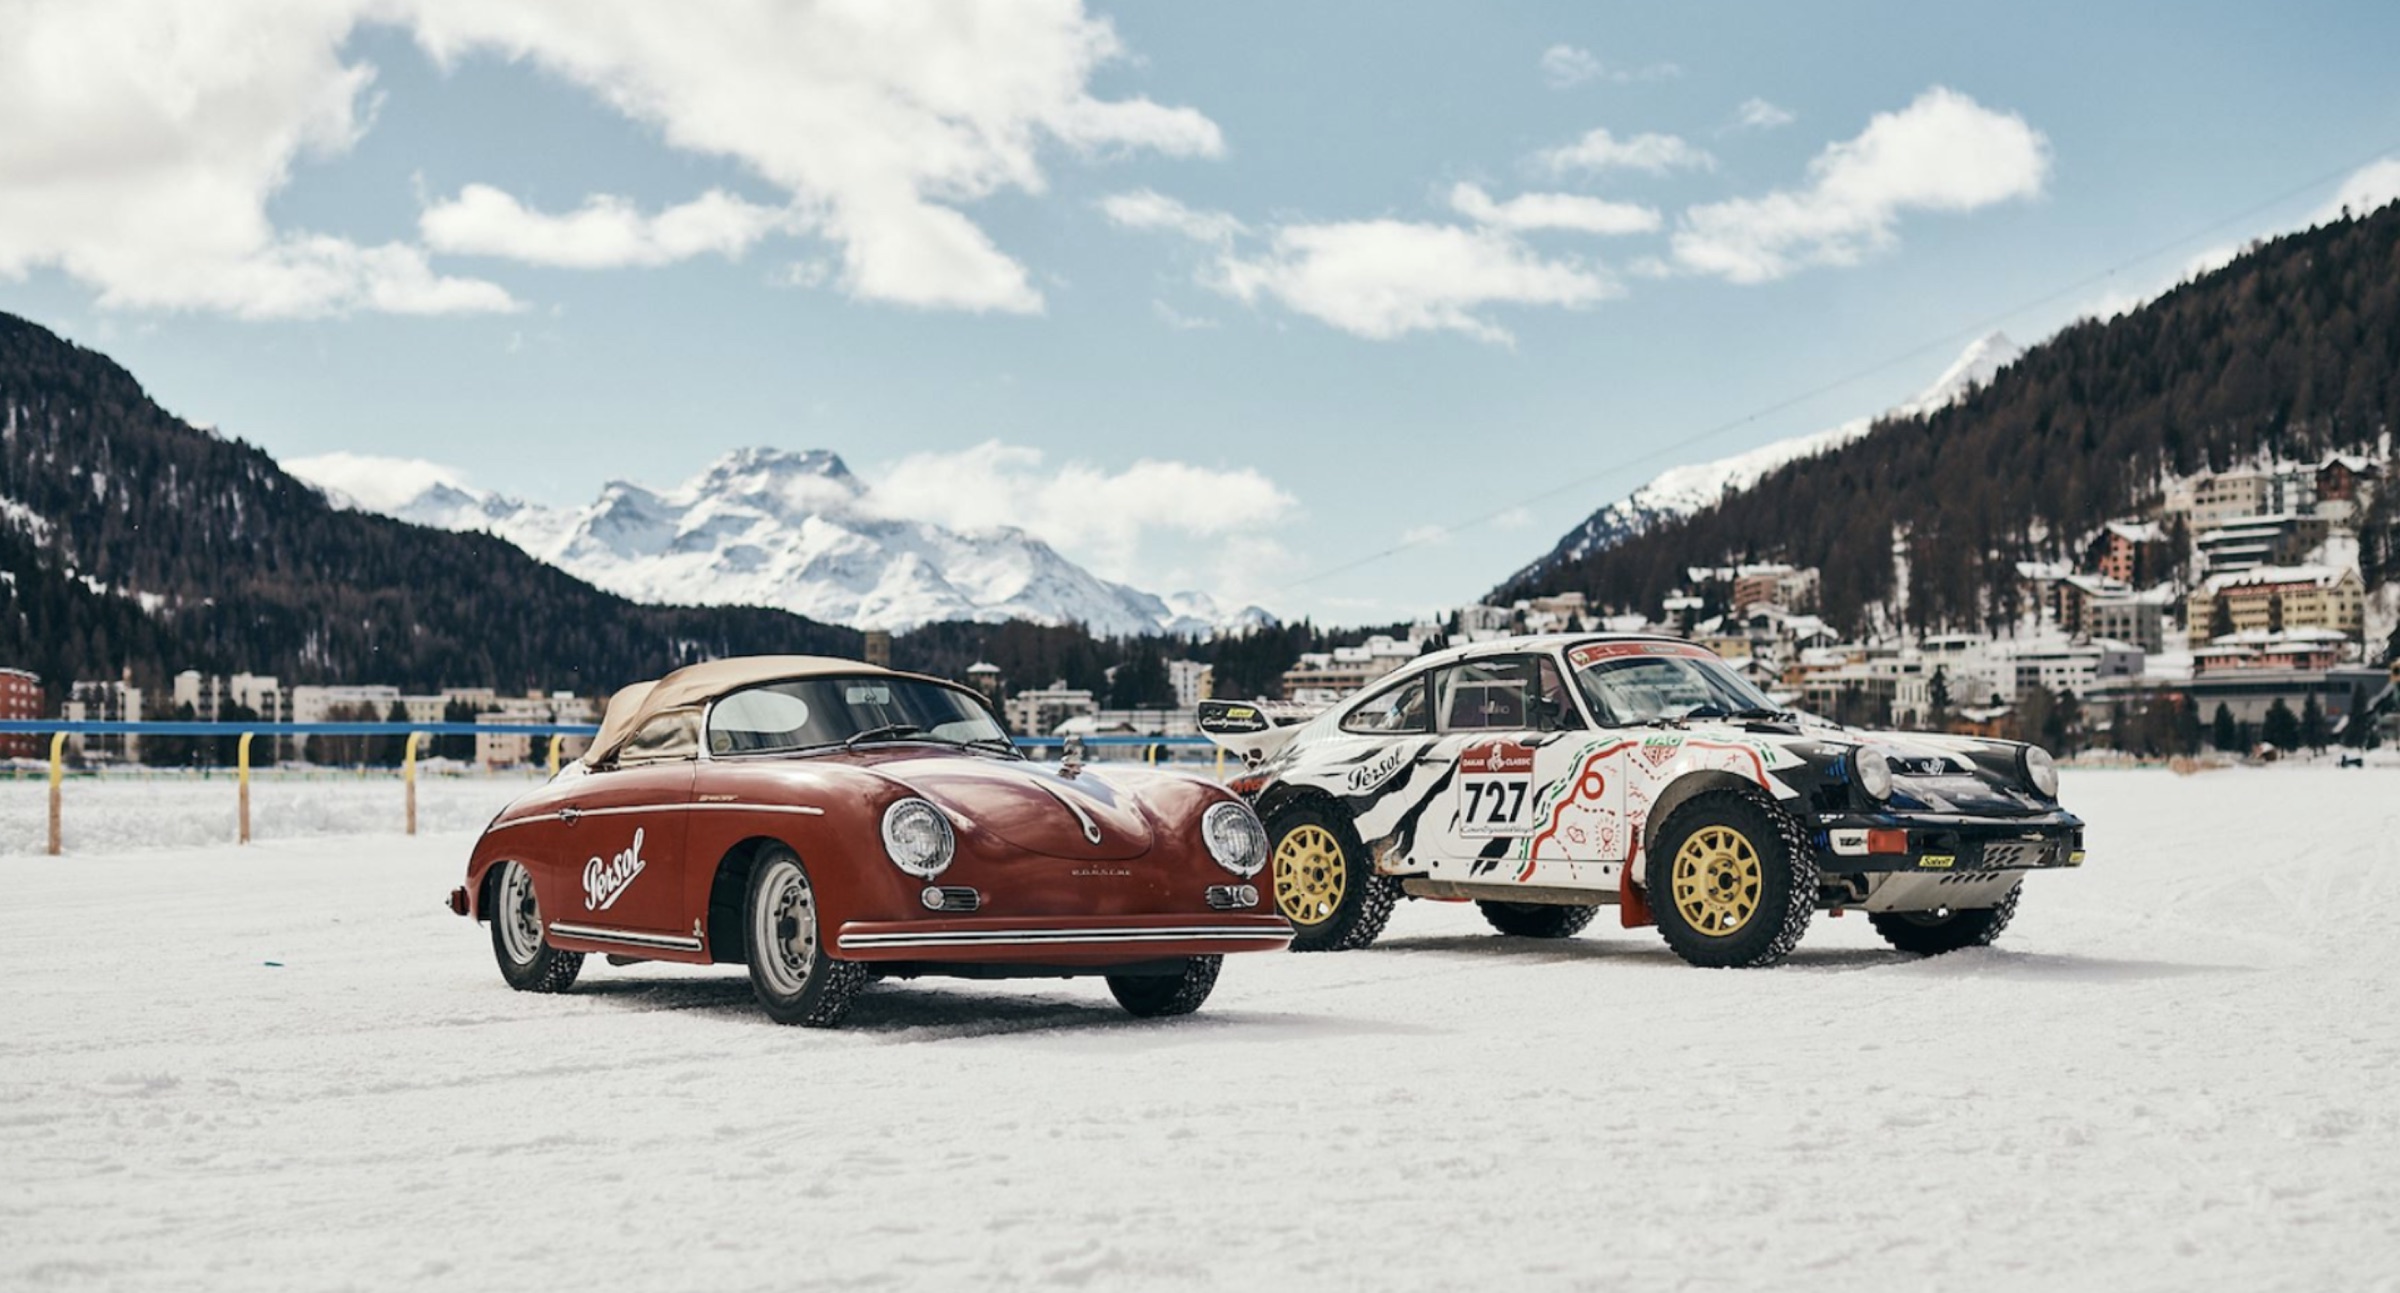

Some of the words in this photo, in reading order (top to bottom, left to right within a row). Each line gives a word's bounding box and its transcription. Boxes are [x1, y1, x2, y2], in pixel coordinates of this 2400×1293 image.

[1648, 736, 1681, 746] TAG
[1347, 745, 1405, 790] Persol
[1505, 758, 1531, 766] CLASSIC
[1464, 780, 1528, 823] 727
[582, 827, 646, 910] Persol
[1071, 868, 1131, 876] PORSCHE
